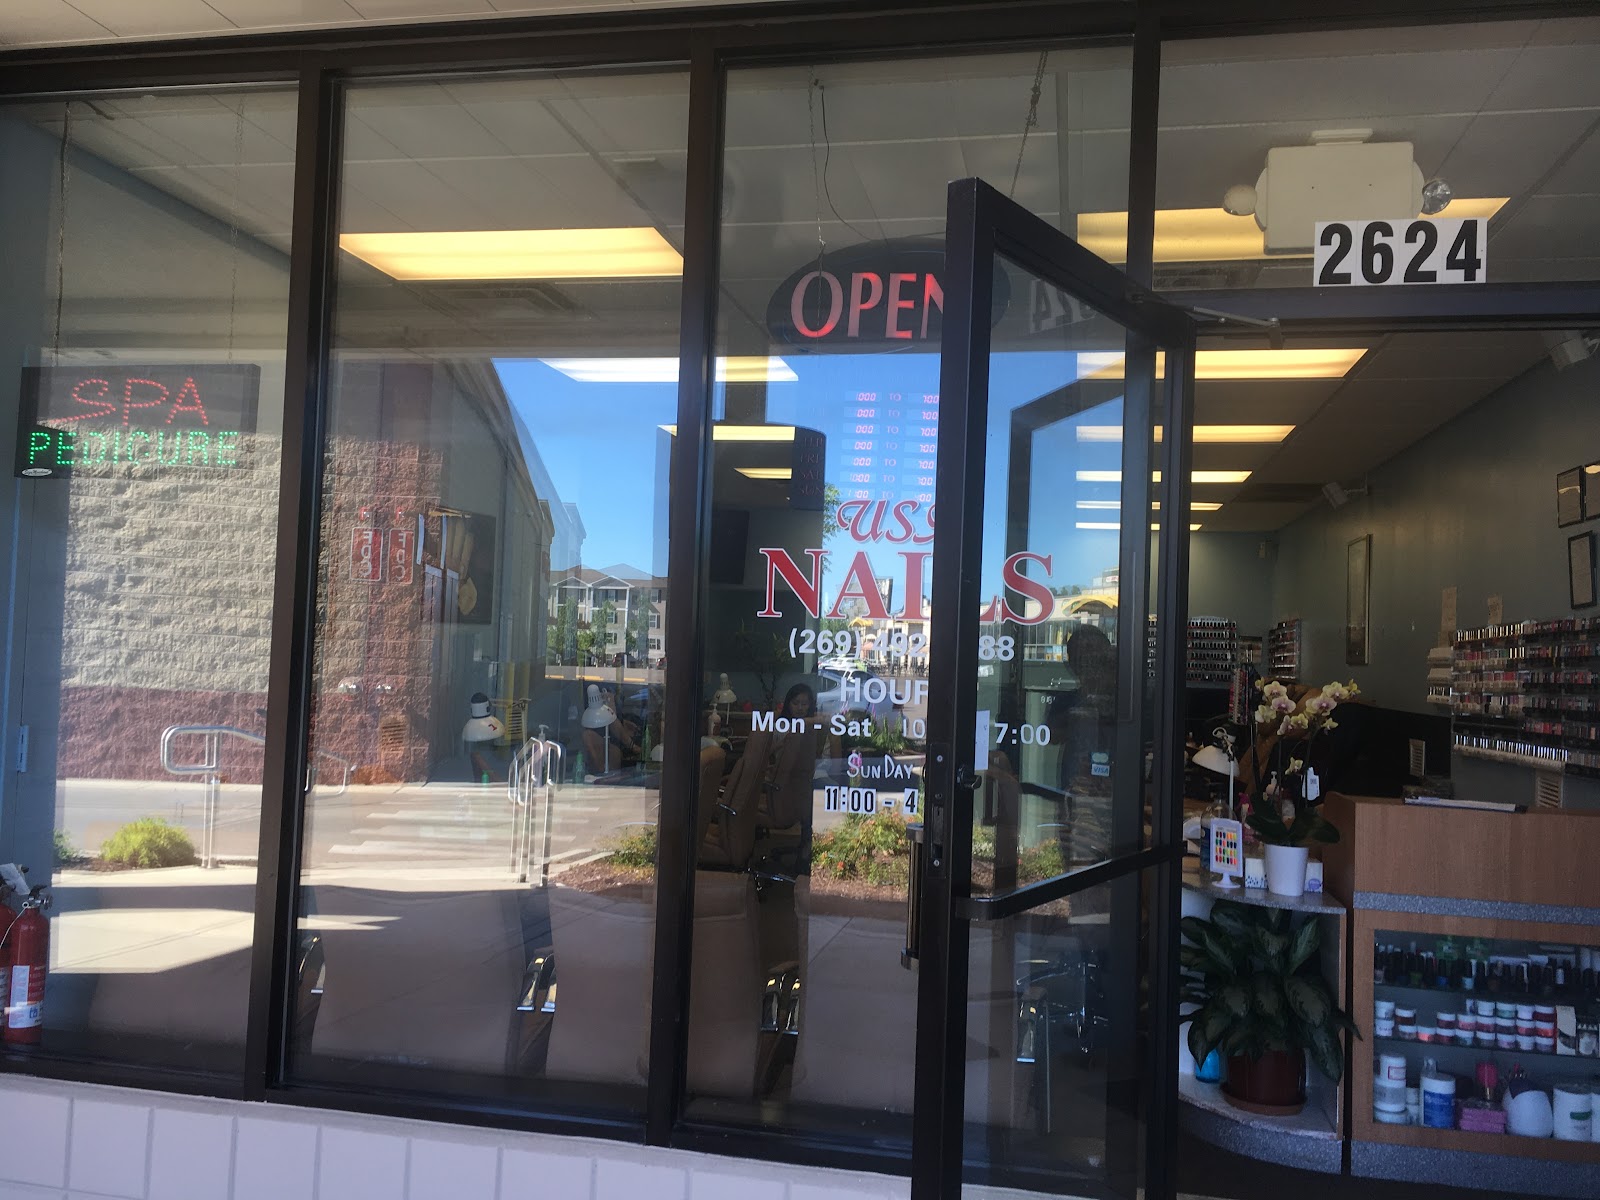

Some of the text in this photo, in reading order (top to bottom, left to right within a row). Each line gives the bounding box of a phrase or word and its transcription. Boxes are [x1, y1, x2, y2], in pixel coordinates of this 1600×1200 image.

[1318, 219, 1482, 285] 2624
[50, 376, 209, 427] SPA
[888, 392, 902, 402] TO
[887, 409, 901, 418] TO
[886, 425, 899, 434] TO
[29, 431, 239, 466] PEDICURE
[885, 442, 898, 450] TO
[884, 458, 897, 467] TO
[882, 474, 896, 483] TO
[881, 491, 895, 499] TO
[756, 547, 1056, 626] NAIS
[789, 627, 861, 660] (269)
[751, 710, 805, 735] Mon
[830, 713, 872, 738] Sat
[994, 722, 1051, 746] 7:00
[1093, 766, 1109, 776] VISA
[825, 787, 875, 813] 11:00
